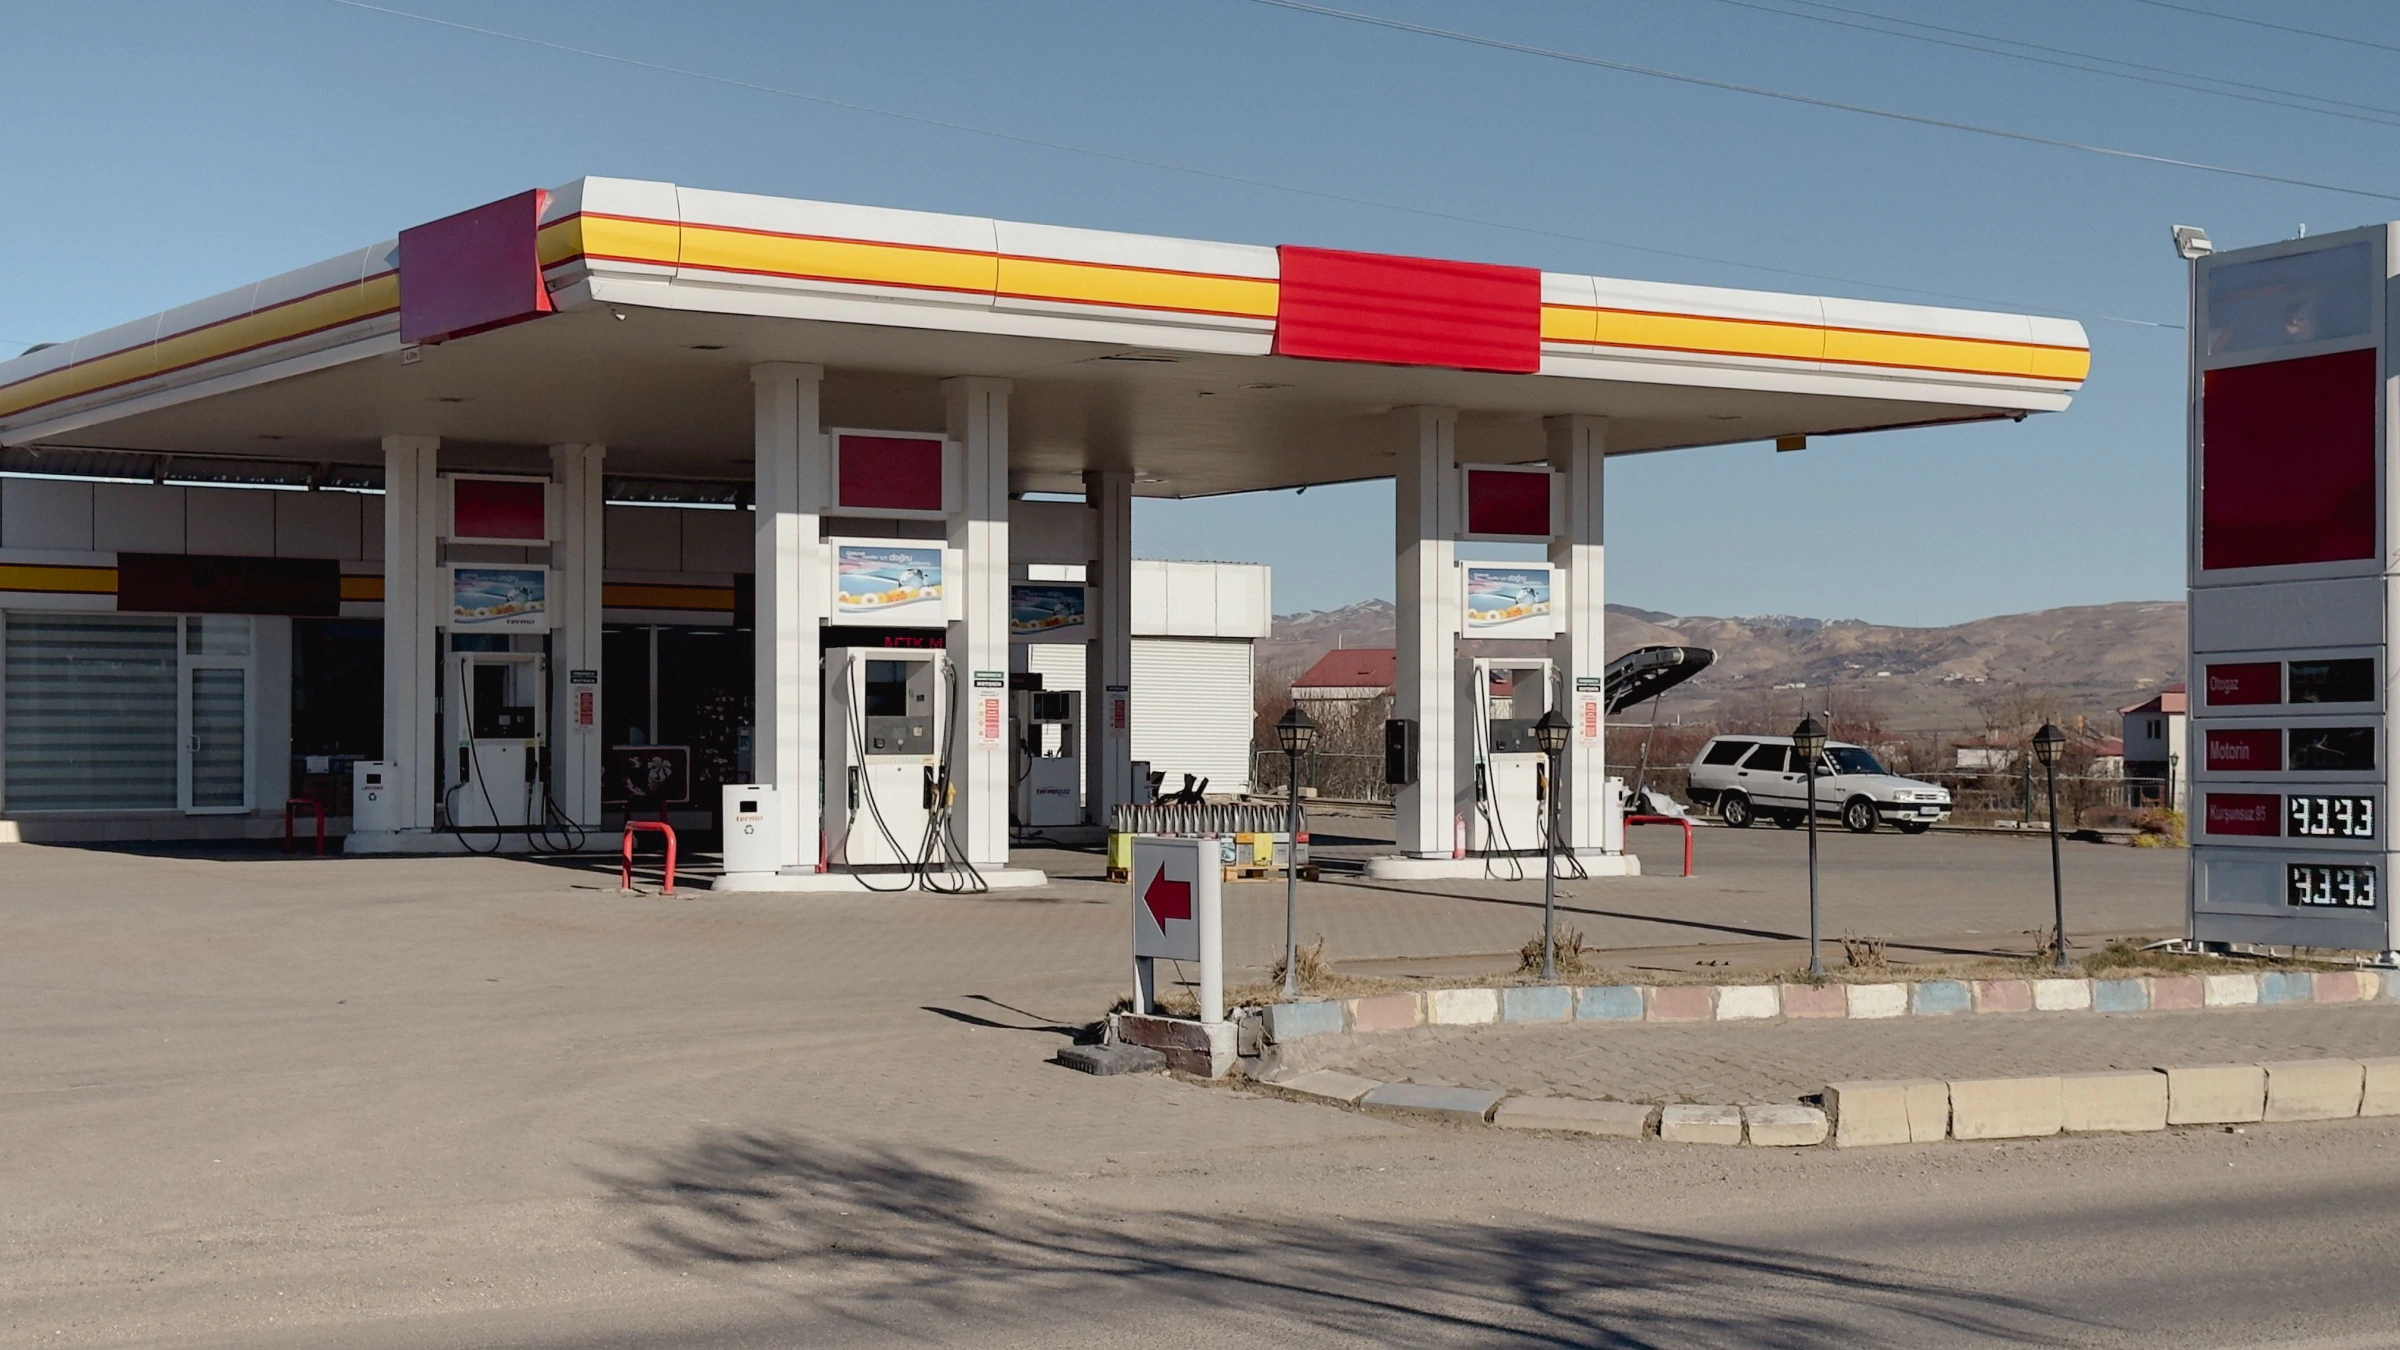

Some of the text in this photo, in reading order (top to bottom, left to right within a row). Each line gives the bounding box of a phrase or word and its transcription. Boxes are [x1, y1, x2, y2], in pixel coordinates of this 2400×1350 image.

[888, 553, 913, 563] doğru
[1507, 574, 1527, 583] doğru
[2209, 676, 2239, 694] Otogaz
[2209, 741, 2250, 760] Motorin
[2209, 804, 2267, 825] Kurşunsuz 95
